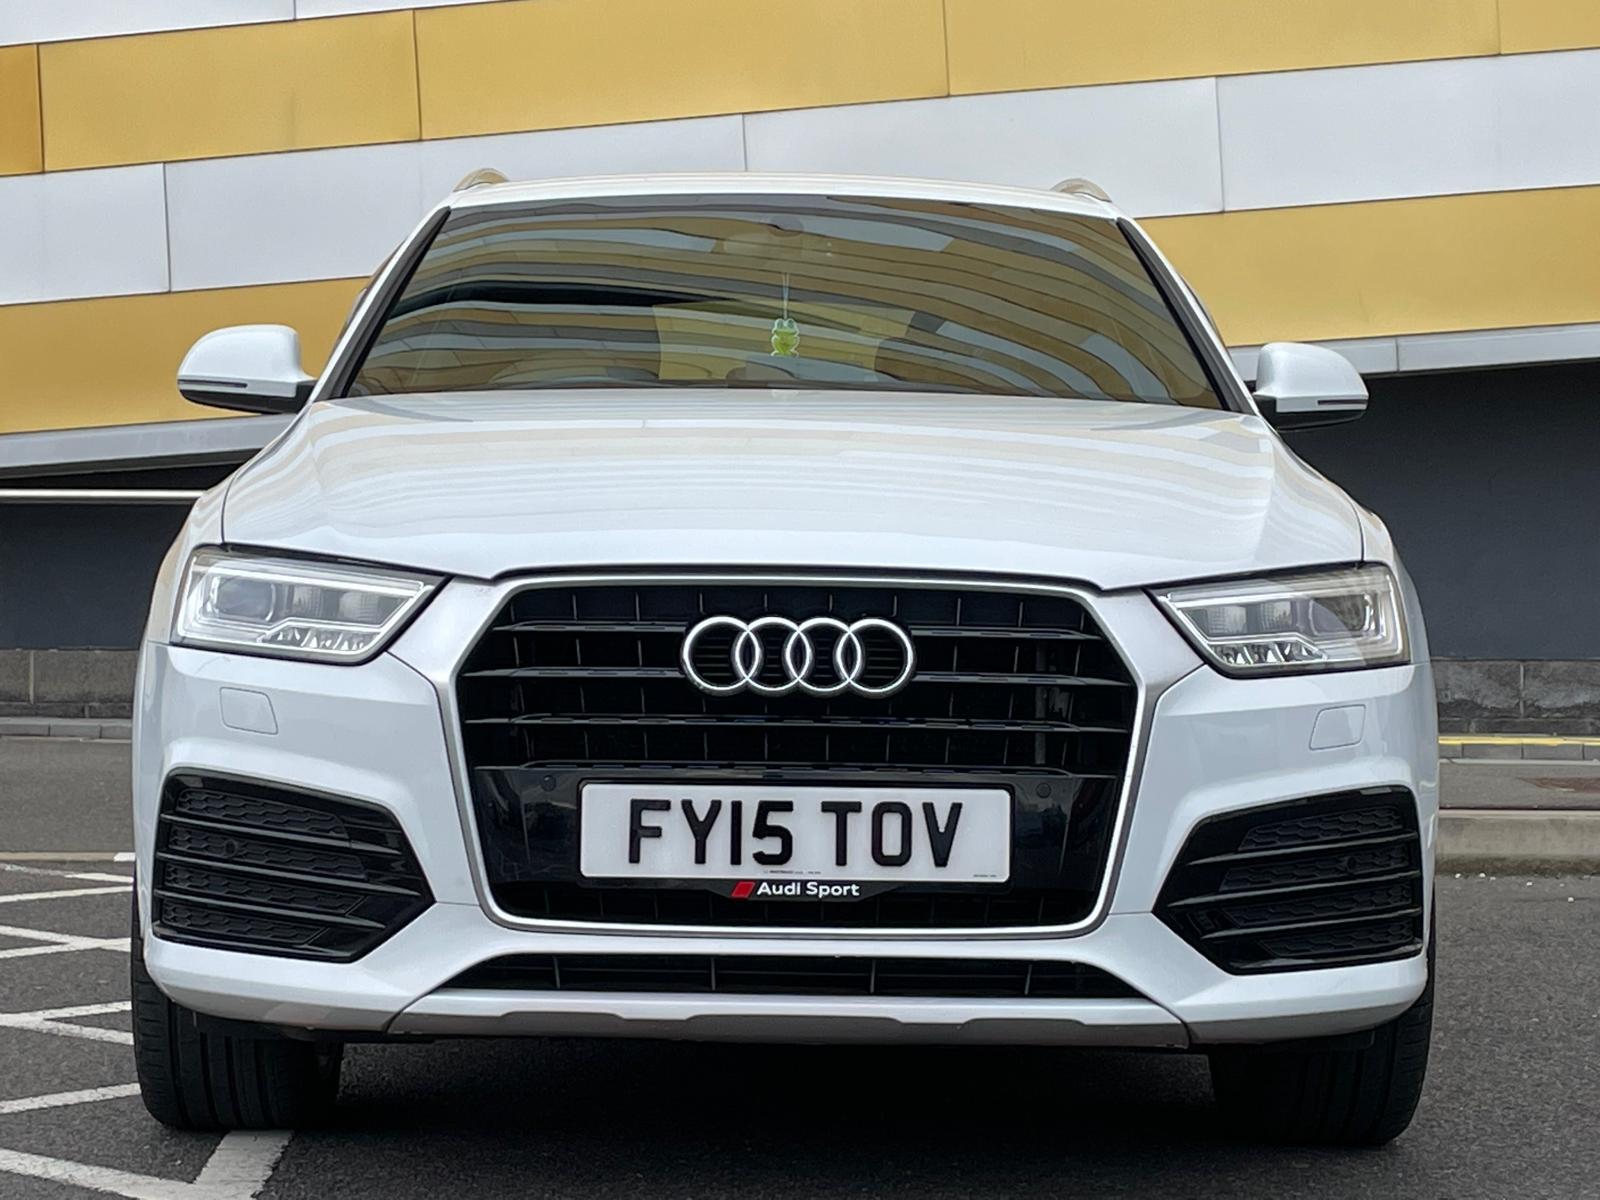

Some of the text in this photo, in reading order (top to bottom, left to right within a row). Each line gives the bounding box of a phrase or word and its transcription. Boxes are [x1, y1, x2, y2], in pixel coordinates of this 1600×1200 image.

[628, 798, 963, 868] FY15 TOV
[756, 881, 860, 898] Audi Sport
